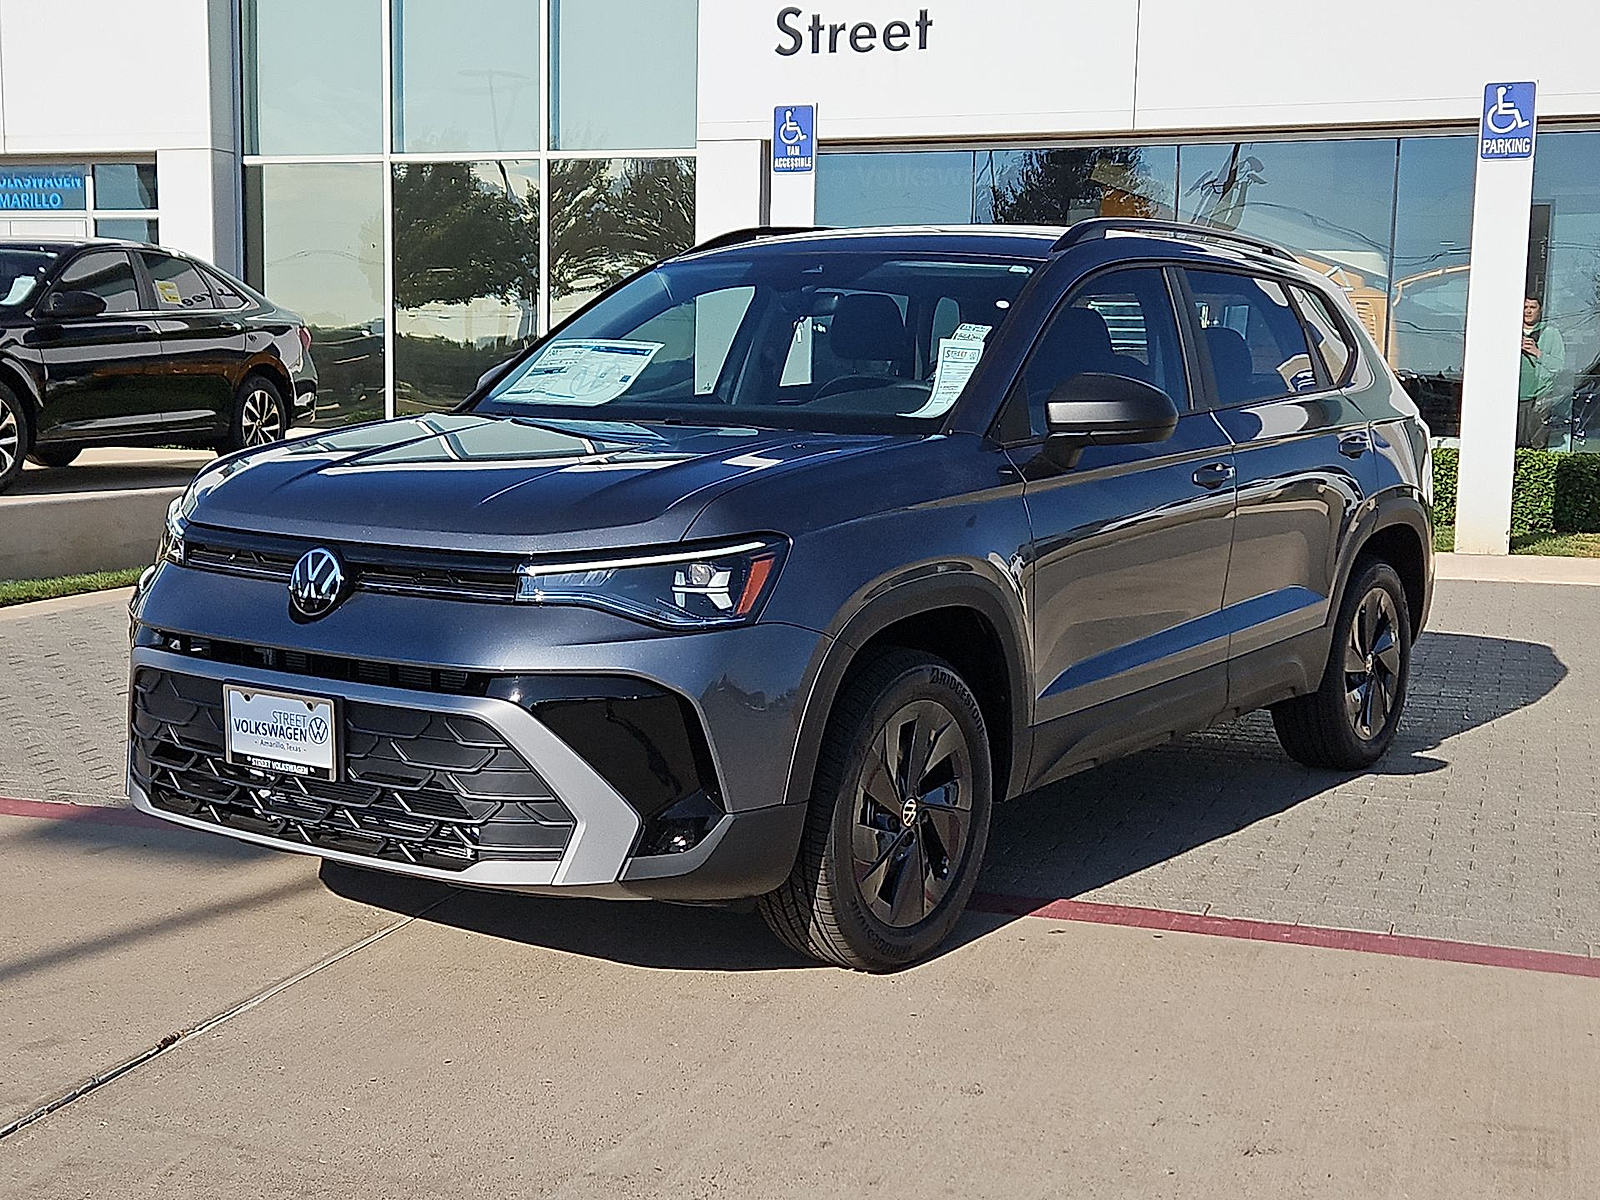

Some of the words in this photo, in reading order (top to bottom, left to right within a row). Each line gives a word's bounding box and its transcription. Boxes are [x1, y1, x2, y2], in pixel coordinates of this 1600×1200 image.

[775, 6, 933, 56] Street
[787, 146, 800, 155] VAN
[1482, 138, 1531, 154] PARKING
[774, 157, 812, 168] ACCESSIBLE
[272, 711, 308, 728] STREET
[234, 718, 308, 742] VOLKSWAGEN
[308, 717, 328, 744] VW
[252, 757, 272, 768] STREET
[272, 761, 308, 774] VOLKSWAGEN
